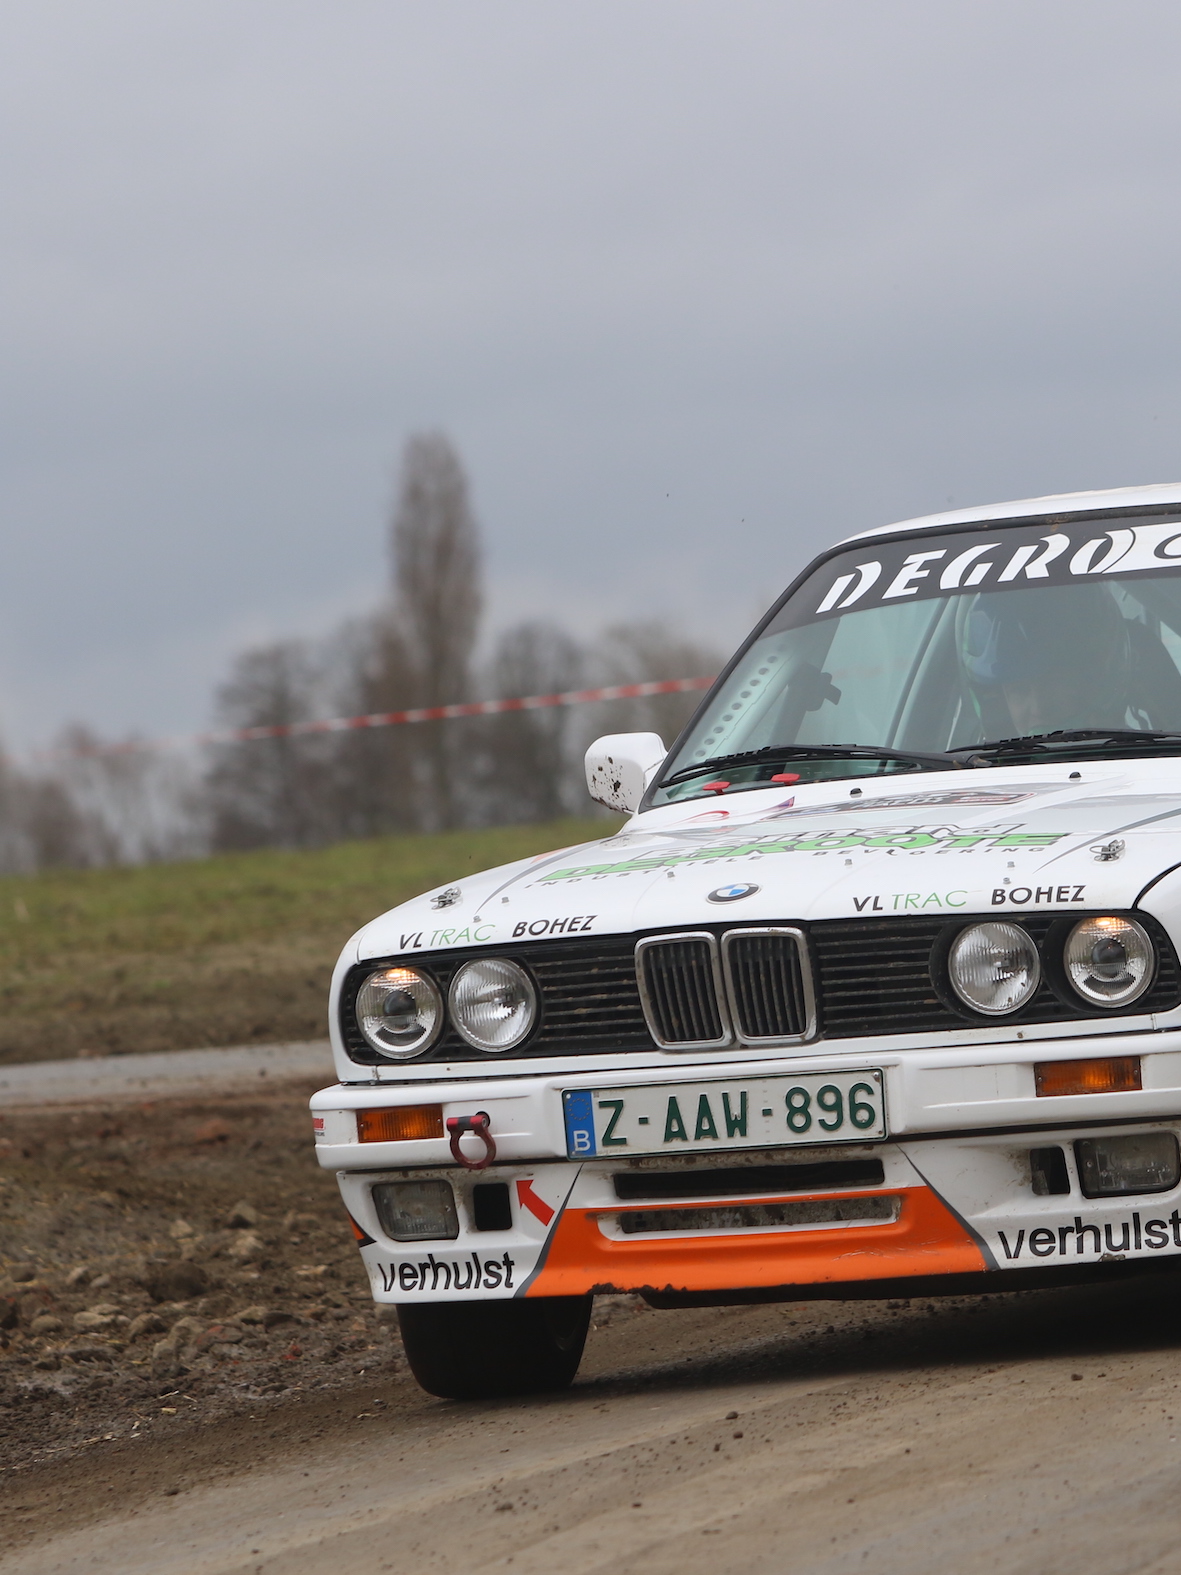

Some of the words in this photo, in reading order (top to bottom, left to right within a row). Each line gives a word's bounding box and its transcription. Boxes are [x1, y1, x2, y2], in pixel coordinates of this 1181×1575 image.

[991, 885, 1086, 905] BOHEZ
[512, 914, 598, 938] BOHEZ
[598, 1082, 876, 1146] Z-AAW-896
[573, 1130, 591, 1151] B
[377, 1251, 515, 1292] verhulst
